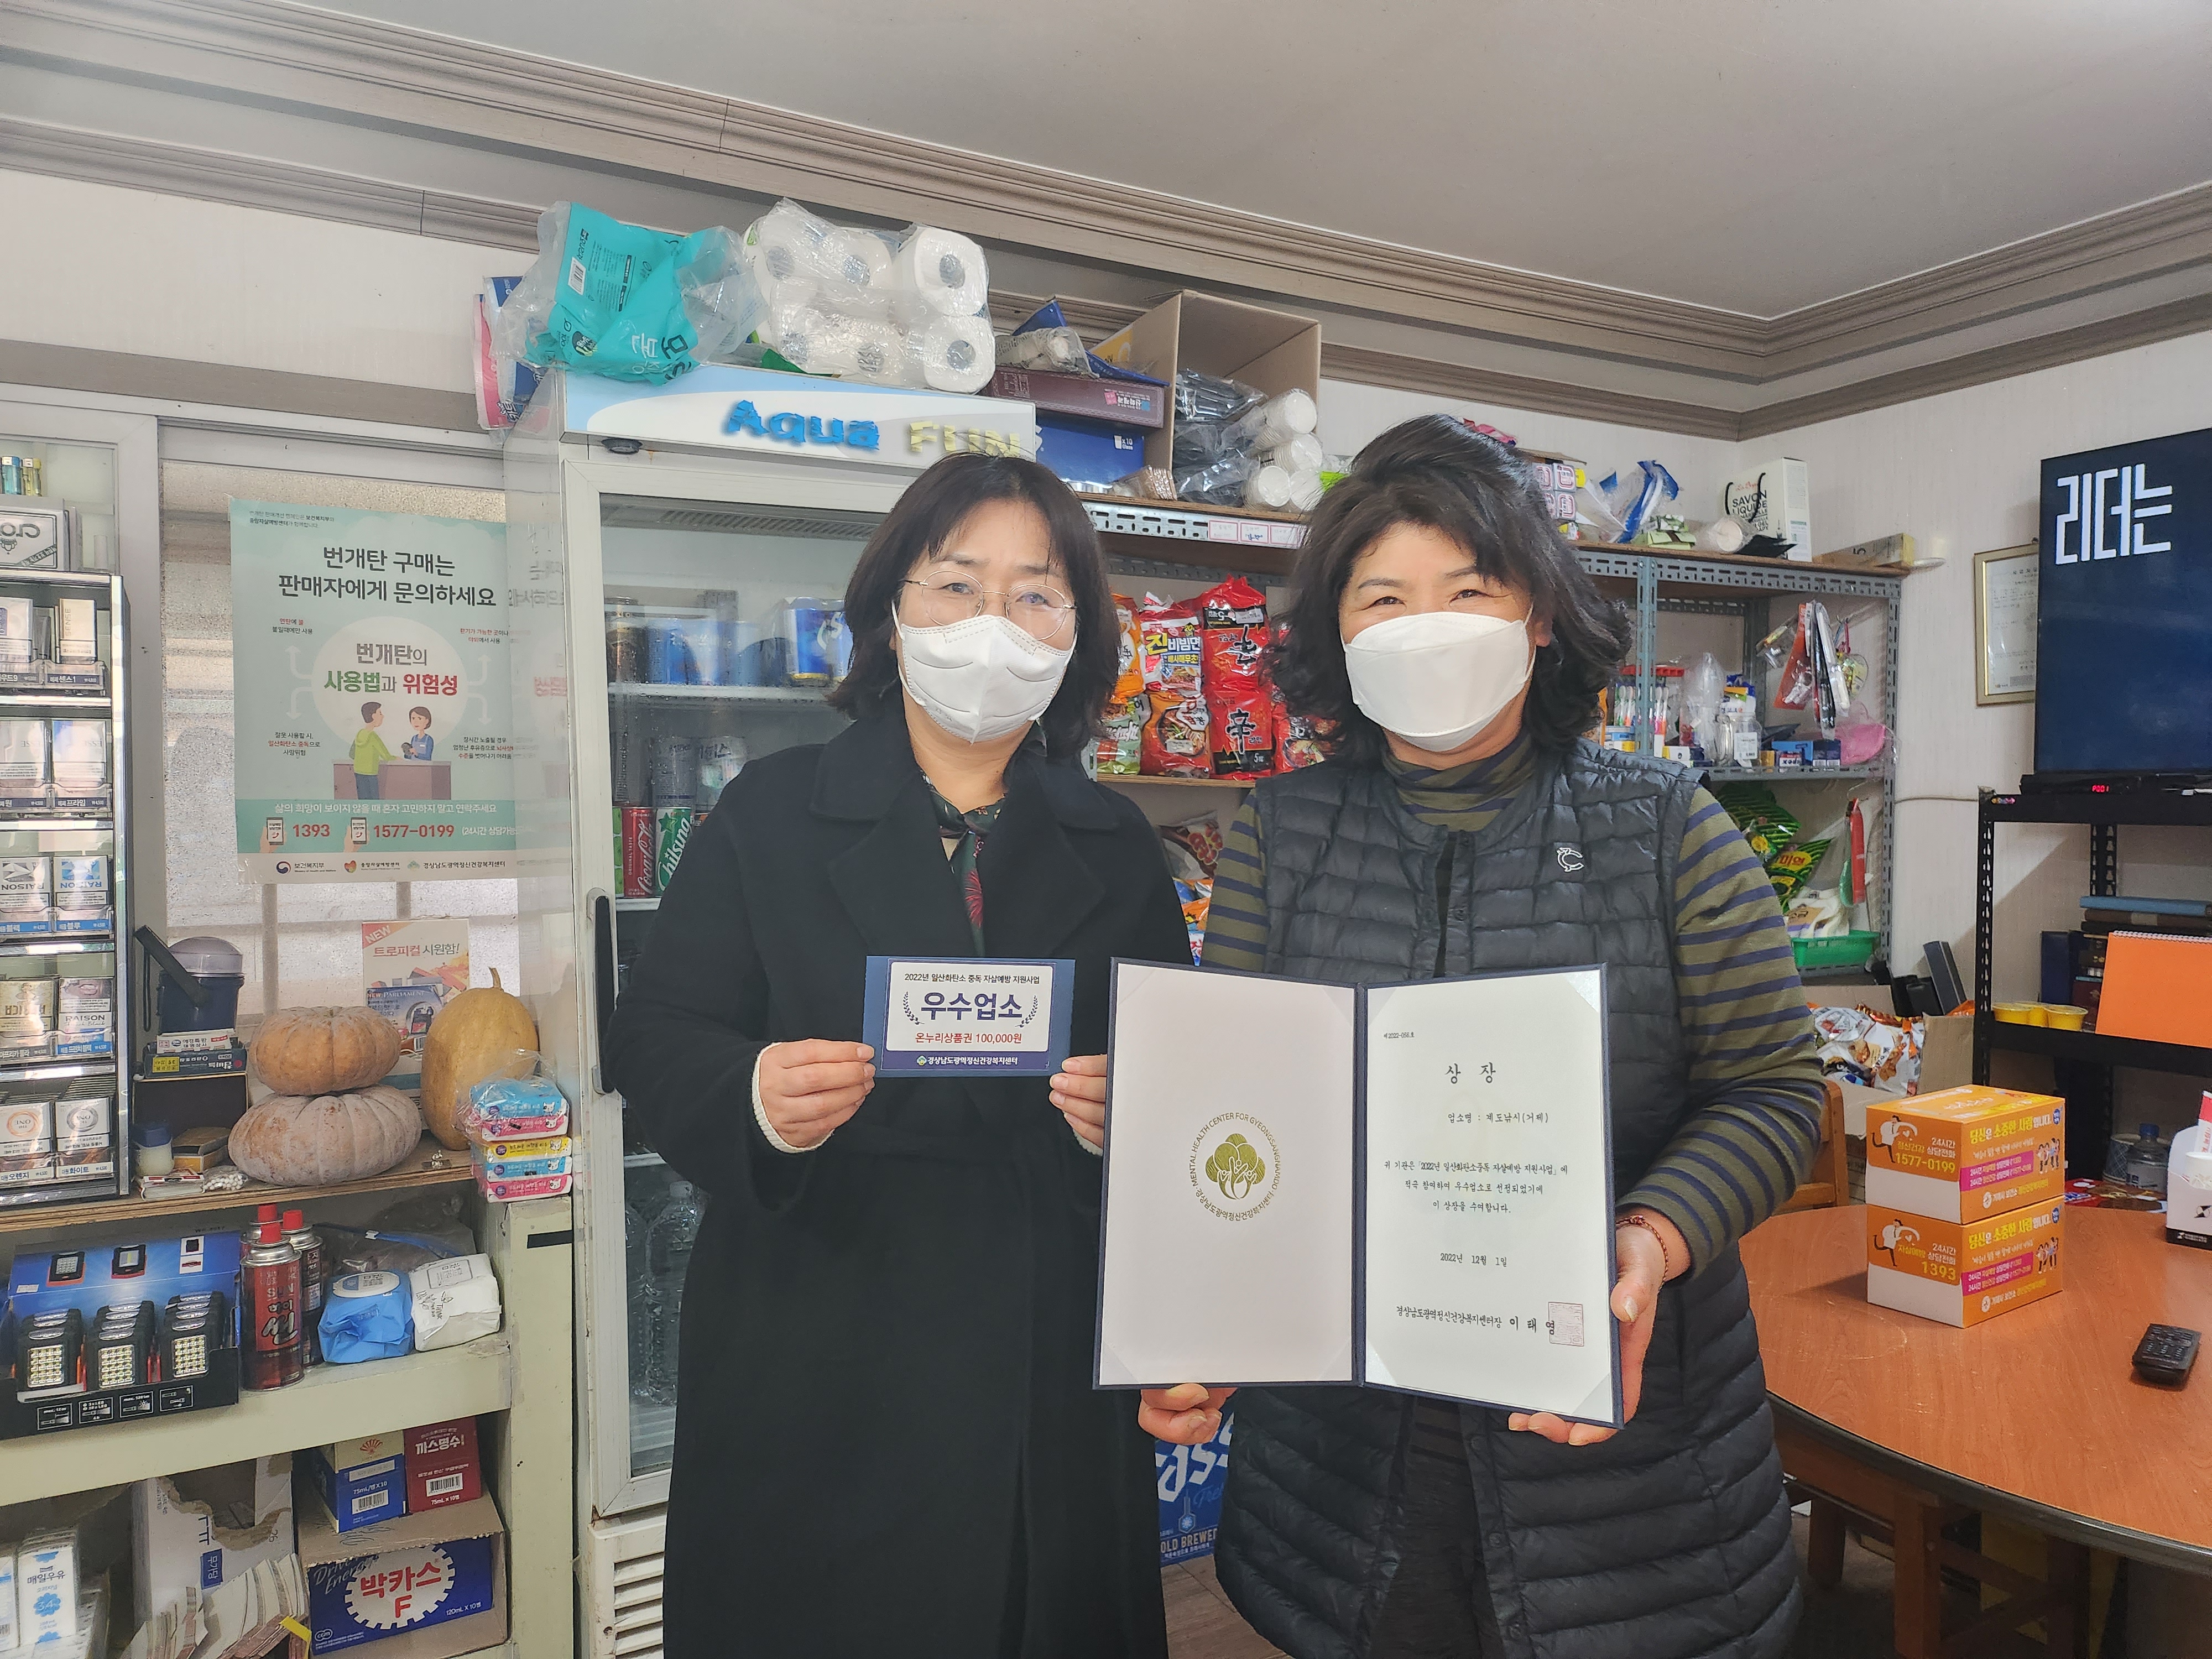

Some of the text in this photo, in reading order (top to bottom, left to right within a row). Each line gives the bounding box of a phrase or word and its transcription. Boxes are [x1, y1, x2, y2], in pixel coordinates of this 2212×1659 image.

[728, 399, 880, 451] Aqua
[1733, 490, 1767, 508] SAVON
[2055, 463, 2172, 565] 리더는
[0, 522, 41, 539] Cro
[324, 546, 456, 577] 번개탄 구매는
[278, 574, 497, 607] 판매자에게 문의하세요
[1145, 633, 1201, 655] 진비빔면
[356, 641, 428, 666] 번개탄의
[324, 670, 458, 696] 사용법과 위험성
[1225, 707, 1256, 755] 辛
[275, 803, 294, 814] 삶의
[295, 803, 322, 814] 희망이
[324, 803, 351, 814] 보이지
[352, 803, 370, 814] 않을
[371, 803, 381, 814] 때
[382, 803, 400, 814] 혼자
[401, 803, 436, 814] 고민하지
[455, 803, 497, 814] 연락주세요
[292, 823, 330, 838] 1393
[373, 824, 455, 838] 1577-0199
[461, 825, 488, 837] (24시간
[658, 817, 692, 891] Chilsung
[422, 860, 506, 869] 경상남도광역정신건강복지센터
[2, 881, 45, 891] RAISON
[60, 881, 102, 889] RAISON
[364, 925, 392, 944] NEW
[373, 943, 460, 957] 트로피컬 시원함!
[904, 973, 1040, 984] 2022년 일산화탄소 중독 자살예방 지원사업
[921, 992, 1022, 1021] 우수업소
[65, 1014, 106, 1022] RAISON
[915, 1032, 1022, 1045] 온누리상품권 100,000원
[927, 1056, 1019, 1066] 경상남도광역정신건강복지센터
[1444, 1062, 1496, 1084] 상 장
[1447, 1112, 1472, 1124] 업소명
[1969, 1114, 2052, 1145] 당신은 소중한 사람입니다.
[1189, 1112, 1281, 1190] MENTAL HEALTH CENTER FOR GYEONGSANGNAMDO
[1932, 1137, 1956, 1150] 24시간
[1926, 1146, 1956, 1159] 상담전화
[1384, 1160, 1391, 1171] 귀
[1394, 1161, 1415, 1171] 기관은
[1443, 1162, 1490, 1175] 일산화탄소중독
[1492, 1164, 1522, 1175] 자살예방
[1560, 1165, 1568, 1176] 에
[1894, 1152, 1956, 1173] 1577-0199
[9, 1172, 29, 1180] 오렌지
[1405, 1180, 1419, 1190] 적극
[1422, 1181, 1451, 1191] 참여하여
[1454, 1181, 1493, 1193] 우수업소로
[1433, 1200, 1512, 1214] 이 상장을 수여합니다.
[1968, 1231, 1992, 1250] 당신은
[1994, 1221, 2016, 1242] 소중한
[1932, 1243, 1956, 1256] 24시간
[1440, 1253, 1508, 1267] 2022년 12월 1일
[1927, 1251, 1956, 1265] 상담전화
[1921, 1261, 1956, 1281] 1393
[1396, 1305, 1503, 1329] 경상남도광역정신건강복지센터장
[1509, 1315, 1519, 1331] 이
[1527, 1318, 1537, 1333] 태
[415, 1436, 461, 1455] 까스명수
[27, 1570, 66, 1584] 매일우유
[360, 1561, 442, 1599] 박카스
[395, 1594, 413, 1618] F
[446, 1608, 463, 1616] 120mL
